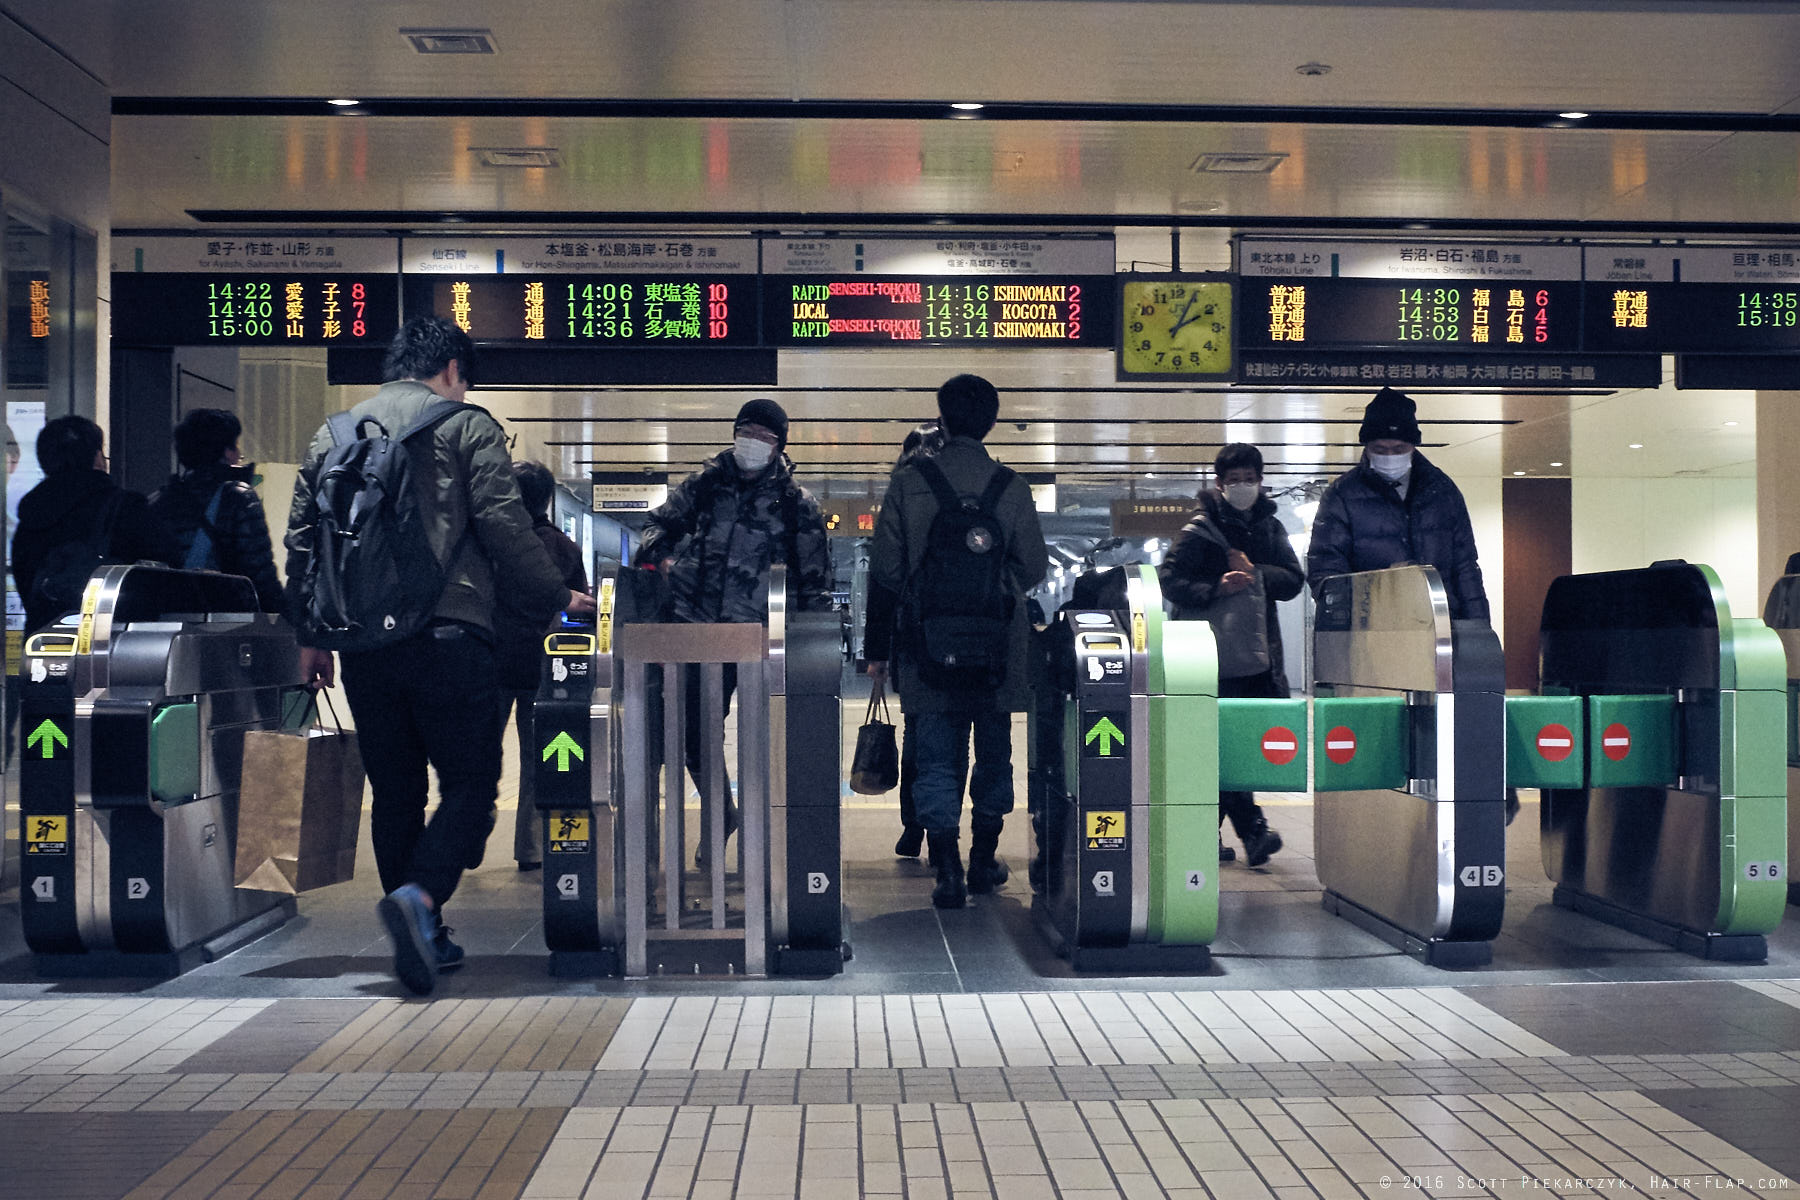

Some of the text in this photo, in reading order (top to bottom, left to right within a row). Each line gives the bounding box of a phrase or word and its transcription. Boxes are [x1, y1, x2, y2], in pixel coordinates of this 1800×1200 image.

[1250, 252, 1321, 264] 東北本線 上り
[208, 283, 272, 300] 14:22
[351, 283, 366, 300] 8
[567, 283, 633, 301] 14:06
[644, 283, 701, 302] 東塩釜
[708, 283, 728, 301] 10
[792, 285, 829, 301] RAPID
[926, 285, 989, 301] 14:16
[993, 285, 1066, 302] ISHINOMAKI
[1068, 285, 1081, 301] 2
[1171, 289, 1185, 299] 12
[1268, 285, 1306, 305] 普通
[1398, 288, 1460, 305] 14:30
[1535, 289, 1549, 306] 6
[891, 295, 922, 304] LINE
[1154, 294, 1167, 303] 11
[1612, 290, 1797, 310] 普通 14:35
[208, 301, 273, 318] 14:40
[352, 302, 366, 318] 7
[567, 302, 632, 320] 14:21
[708, 302, 728, 320] 10
[793, 303, 1081, 321] LOCAL 14:34 KOGOTA 2
[1141, 305, 1155, 315] 10
[1204, 304, 1214, 314] 2
[1268, 304, 1306, 323] 普通
[1398, 307, 1459, 323] 14:53
[1534, 308, 1548, 325] 4
[1612, 310, 1796, 328] 普通 15:19
[208, 320, 273, 336] 15:00
[351, 320, 366, 337] 8
[567, 321, 633, 338] 14:36
[644, 320, 701, 339] 多賀城
[708, 321, 728, 339] 10
[792, 321, 829, 338] RAPID
[926, 321, 989, 338] 15:14
[993, 322, 1066, 338] ISHINOMAKI
[1068, 322, 1081, 339] 2
[1133, 322, 1144, 332] 9
[1211, 322, 1221, 333] 3
[1268, 323, 1306, 342] 普通
[1397, 324, 1459, 341] 15:02
[1534, 326, 1548, 343] 5
[891, 332, 922, 340] LINE
[1141, 340, 1151, 351] 8
[1203, 341, 1213, 351] 4
[1156, 352, 1165, 362] 7
[1172, 356, 1182, 366] 6
[1190, 352, 1199, 362] 5
[1467, 870, 1496, 882] 4 5
[1749, 865, 1777, 877] 5 6
[565, 879, 574, 890] 2
[813, 876, 821, 888] 3
[1100, 875, 1109, 887] 3
[1190, 874, 1199, 886] 4
[41, 881, 47, 892] 1
[133, 882, 142, 894] 2
